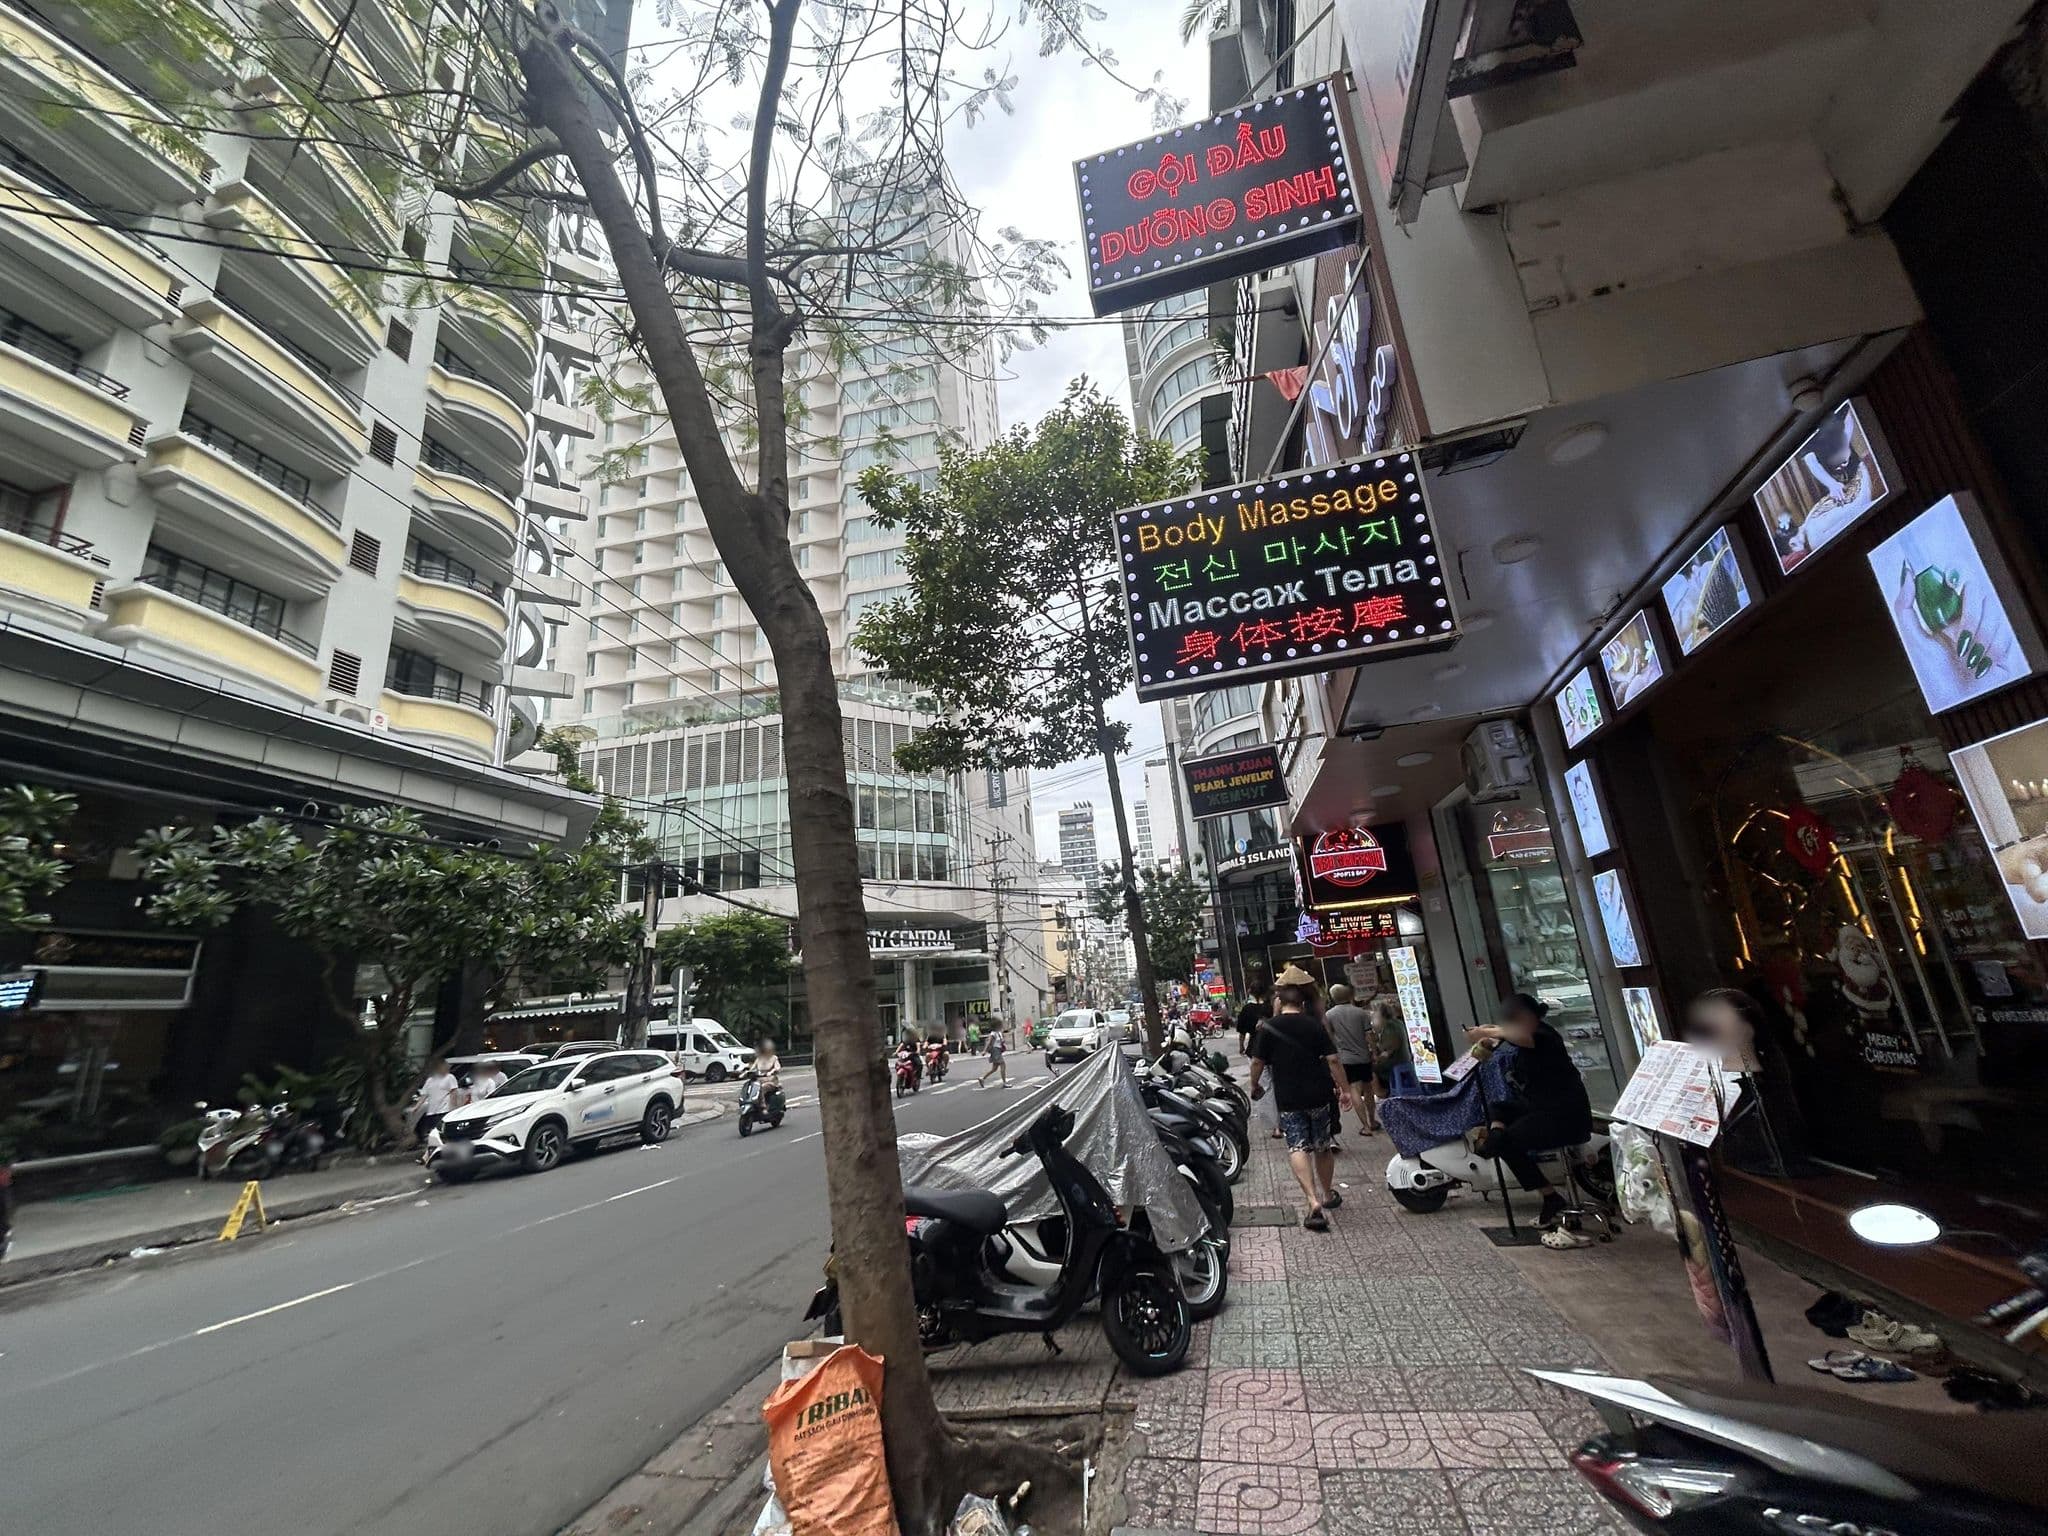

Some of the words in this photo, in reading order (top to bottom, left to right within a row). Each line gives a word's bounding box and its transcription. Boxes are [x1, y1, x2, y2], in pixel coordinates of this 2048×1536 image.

[1126, 153, 1198, 200] GỘI
[1206, 123, 1288, 176] ĐẦU
[1101, 198, 1236, 264] DƯỠNG
[1244, 166, 1337, 221] SINH
[1138, 513, 1225, 552] Body
[1237, 479, 1398, 532] Massage
[1153, 549, 1240, 592] 전신
[1264, 516, 1402, 565] 마사지
[1149, 580, 1307, 630] Массаж
[1315, 559, 1420, 597] Тела
[1176, 595, 1408, 664] 身体按摩
[1194, 780, 1229, 793] PEARL
[1229, 770, 1274, 787] JEWELRY
[1208, 785, 1266, 806] ЖЕМЧУГ
[1247, 847, 1291, 864] ISLAND
[889, 929, 954, 948] CENTRAL
[968, 1001, 990, 1014] KTV
[1866, 1032, 1899, 1050] MERRY
[1864, 1046, 1917, 1065] CHRISTMAS
